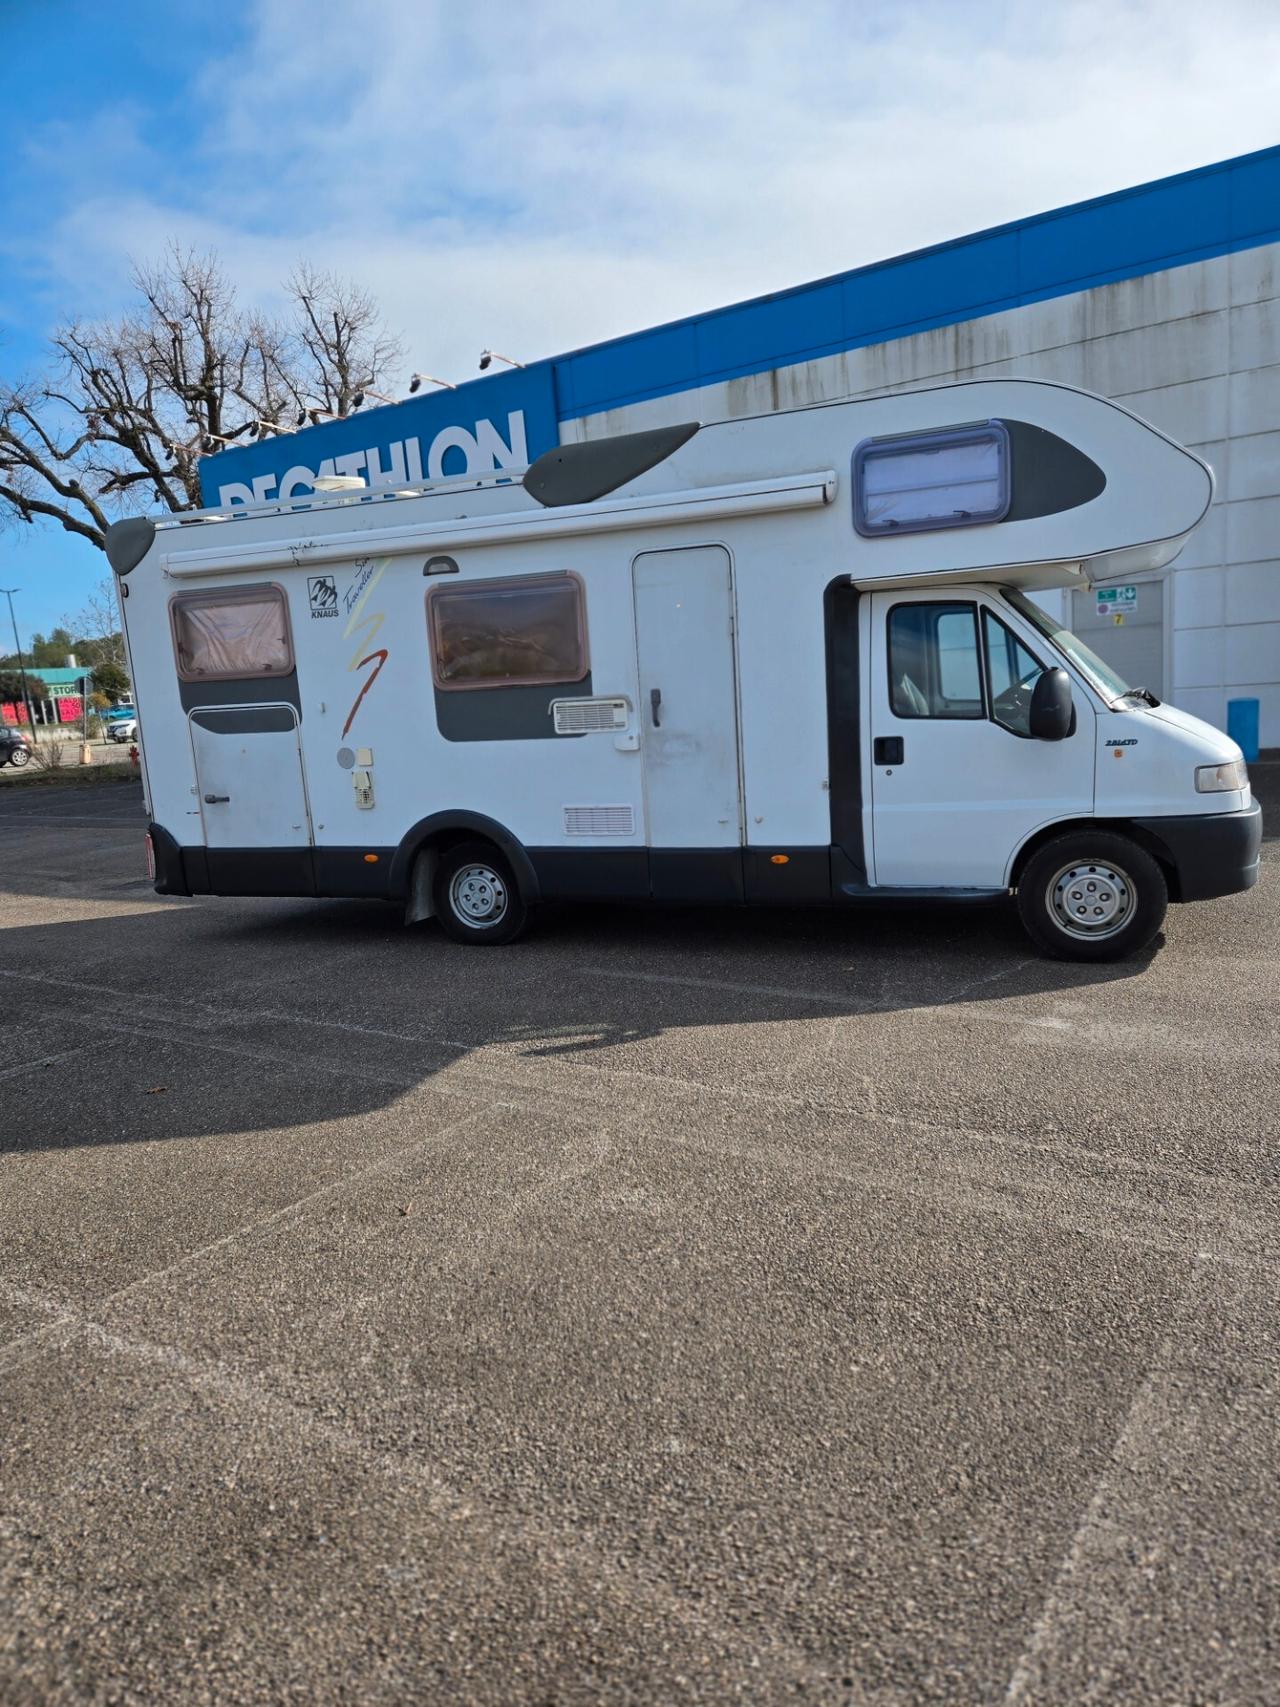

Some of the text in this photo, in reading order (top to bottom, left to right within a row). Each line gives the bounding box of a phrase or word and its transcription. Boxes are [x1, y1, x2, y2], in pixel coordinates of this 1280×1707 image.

[311, 609, 339, 619] KNAUS
[1115, 614, 1123, 624] 7
[53, 686, 79, 695] STOR
